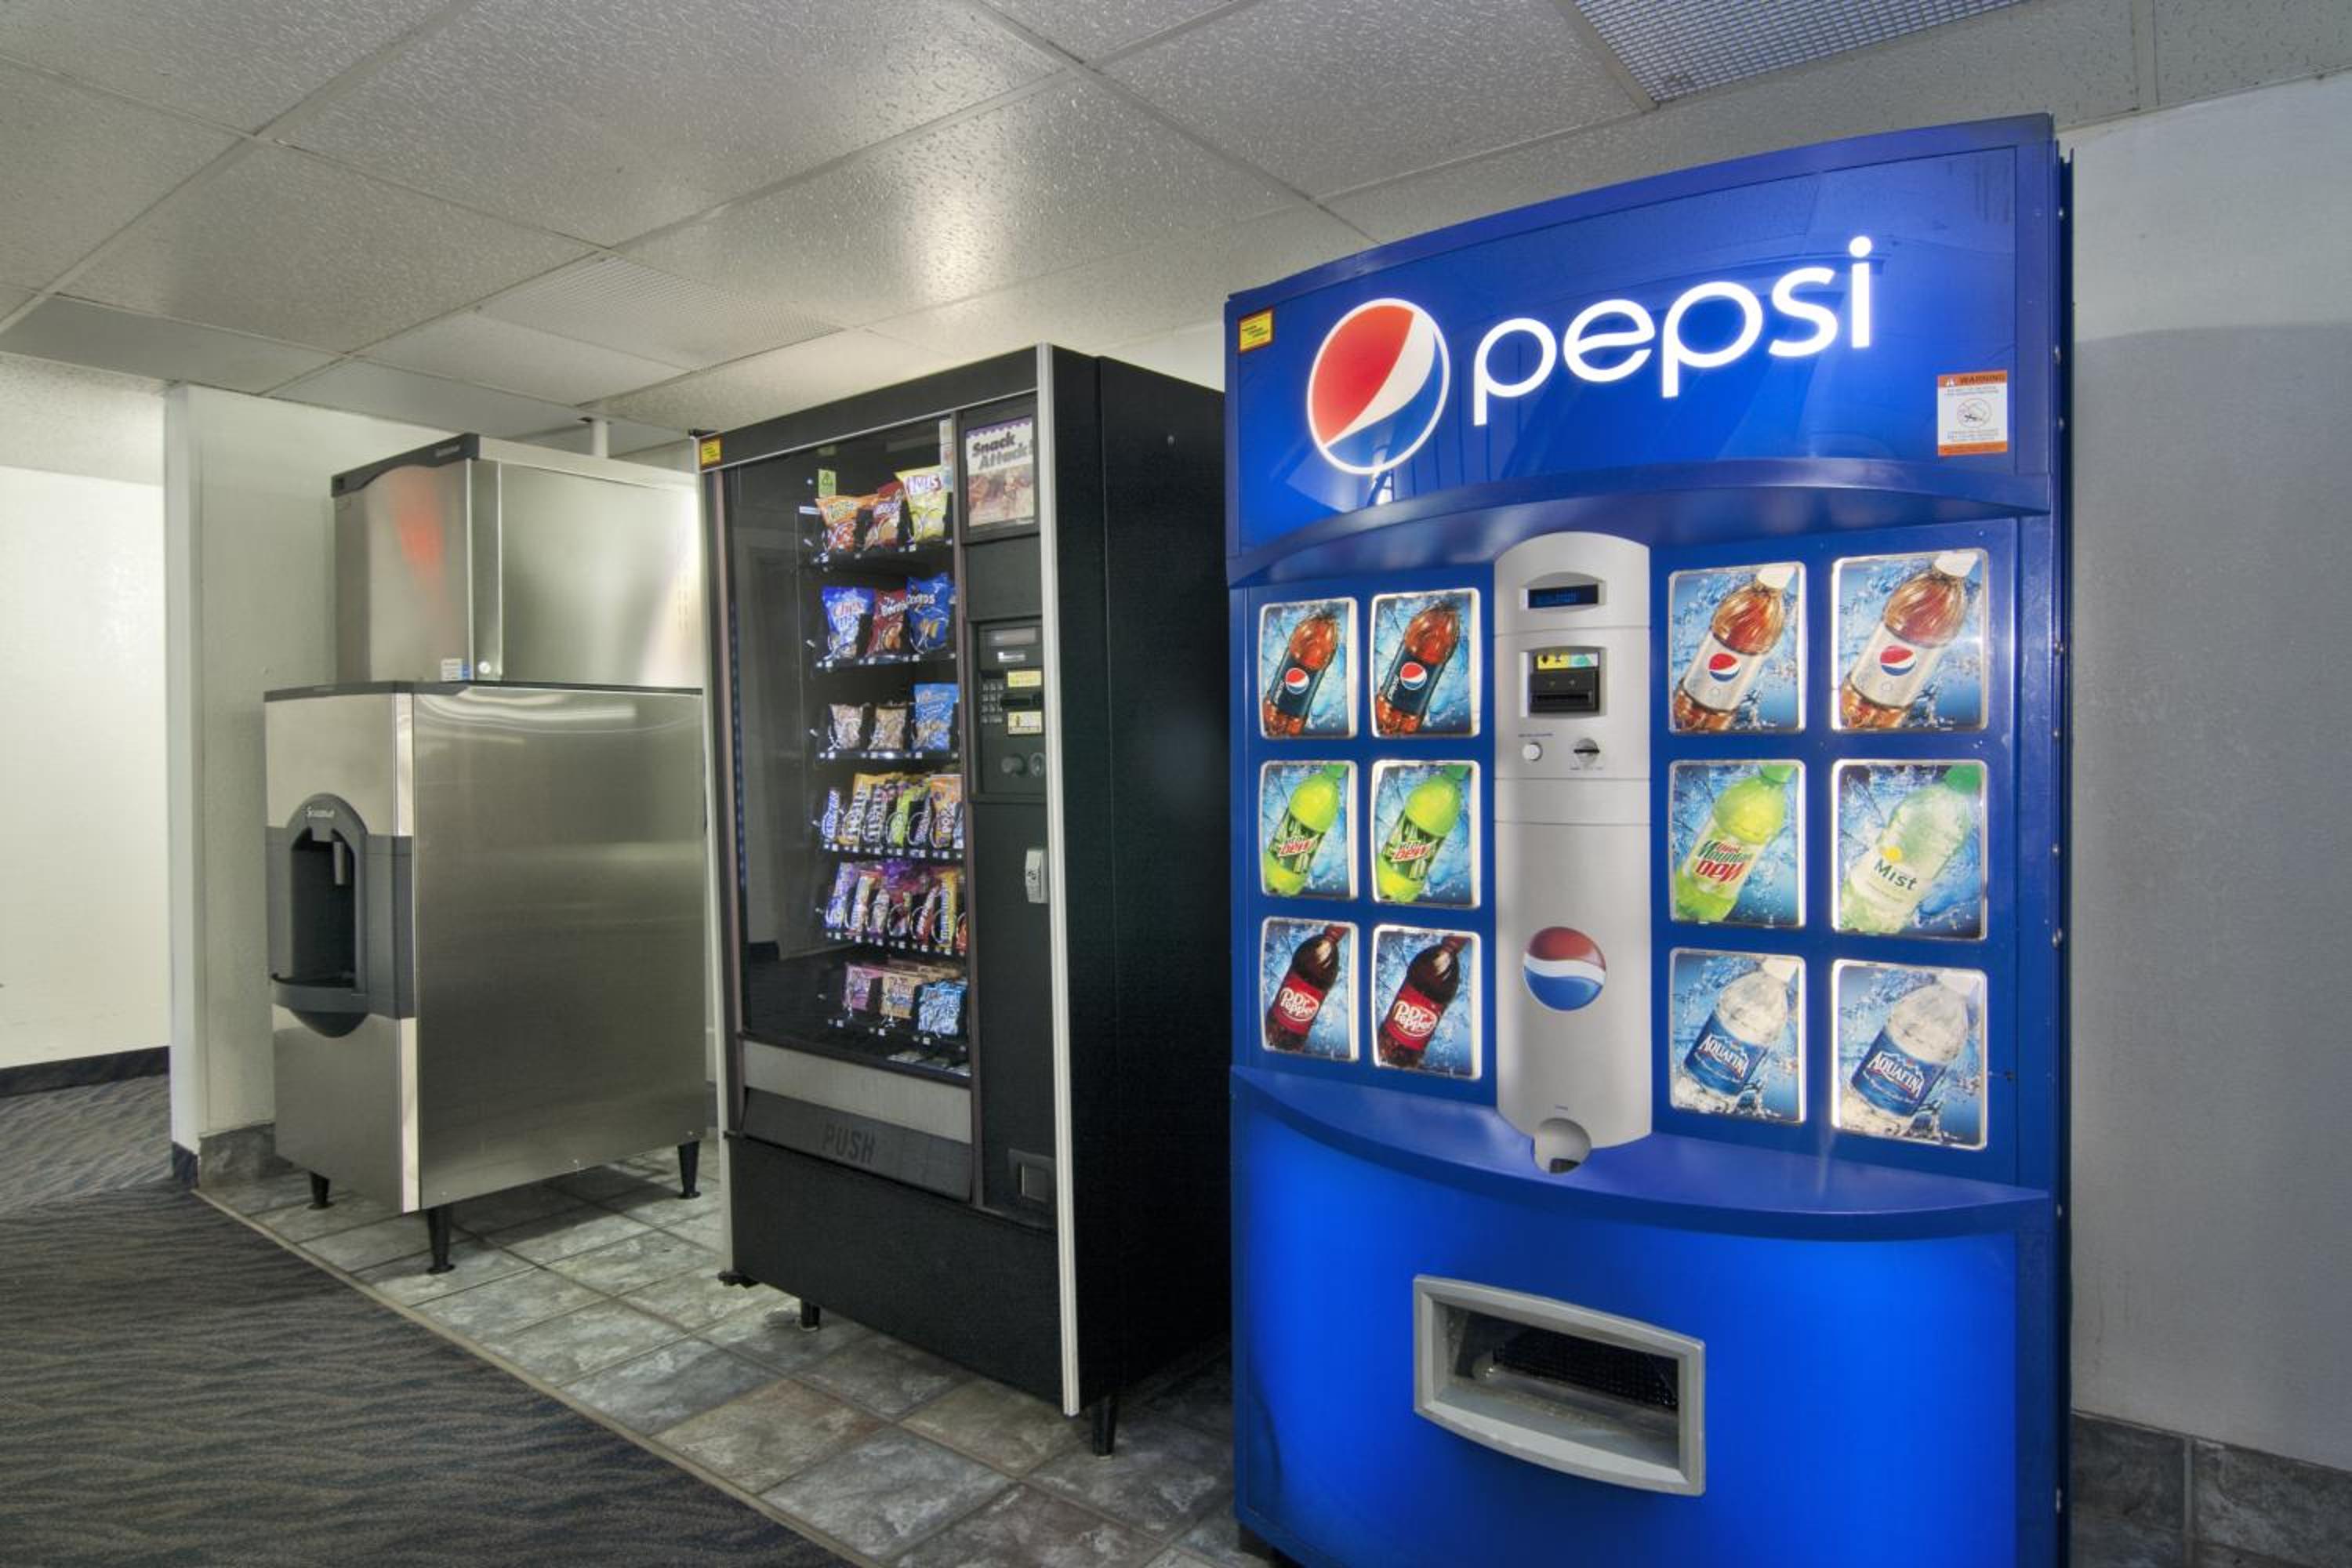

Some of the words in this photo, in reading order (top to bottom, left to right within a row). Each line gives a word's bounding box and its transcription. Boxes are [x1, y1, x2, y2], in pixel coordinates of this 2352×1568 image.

[1474, 236, 1872, 426] pepsi
[1960, 374, 2005, 386] WARNING
[972, 430, 1016, 457] Snack
[1294, 992, 1311, 1008] Dr
[1392, 1000, 1434, 1032] Pepper
[1410, 1006, 1428, 1022] Dr
[1697, 1033, 1748, 1080] AQUAFINA
[1867, 1051, 1924, 1098] AQUAFINA
[822, 1124, 876, 1165] PUSH
